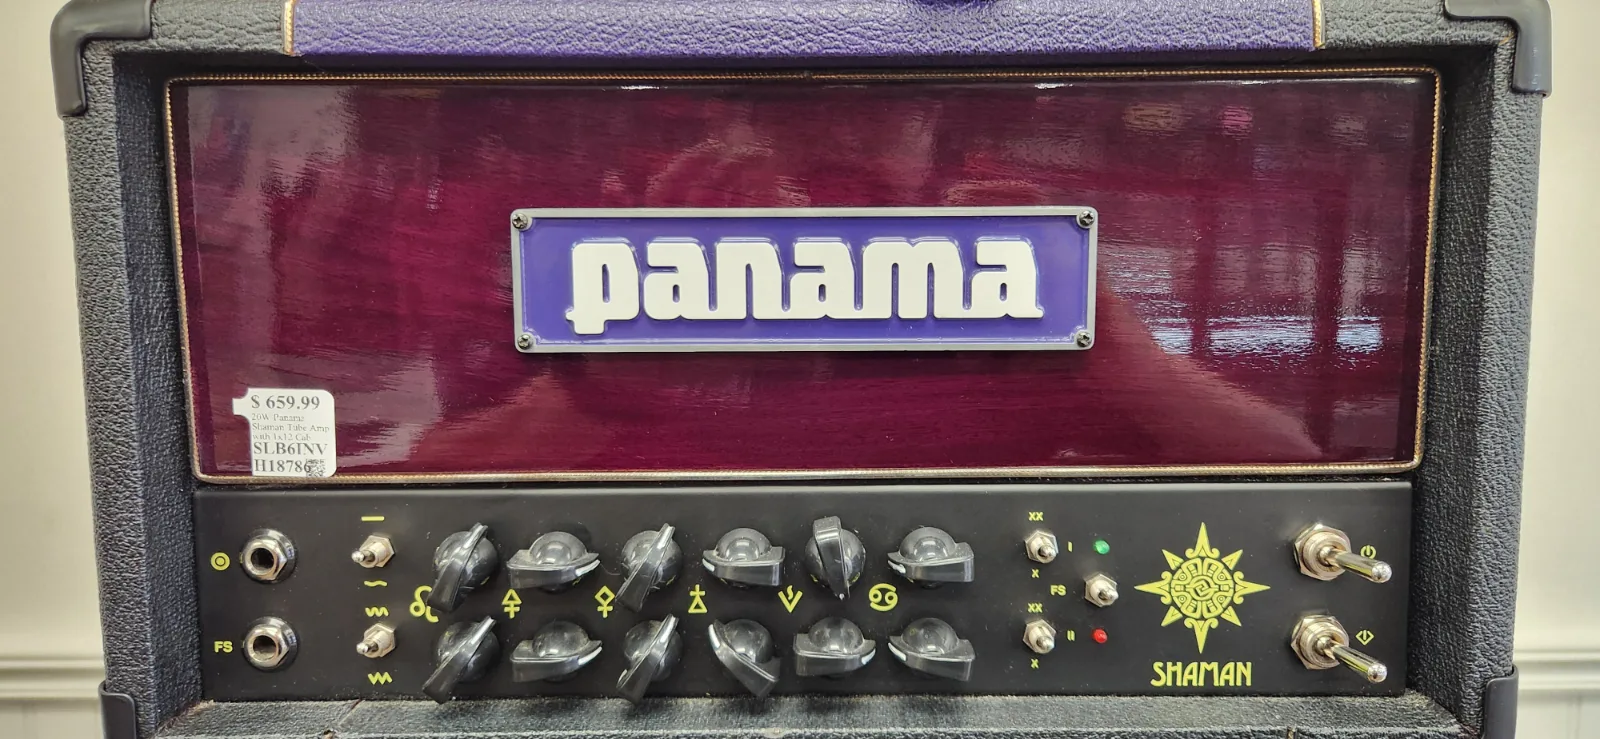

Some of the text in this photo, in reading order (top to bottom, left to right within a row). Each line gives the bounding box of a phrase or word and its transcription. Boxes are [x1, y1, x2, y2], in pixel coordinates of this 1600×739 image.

[565, 239, 1044, 335] panama
[251, 395, 320, 410] $ 659.99
[252, 413, 304, 422] 20W Panama
[252, 423, 330, 433] Shaman Tube Amp
[252, 433, 311, 441] with 1x12 Cab
[254, 442, 327, 455] SLB6INV
[255, 459, 311, 472] H18786
[1050, 584, 1067, 596] FS
[214, 640, 233, 653] FS
[1150, 661, 1252, 687] SHAMAN
